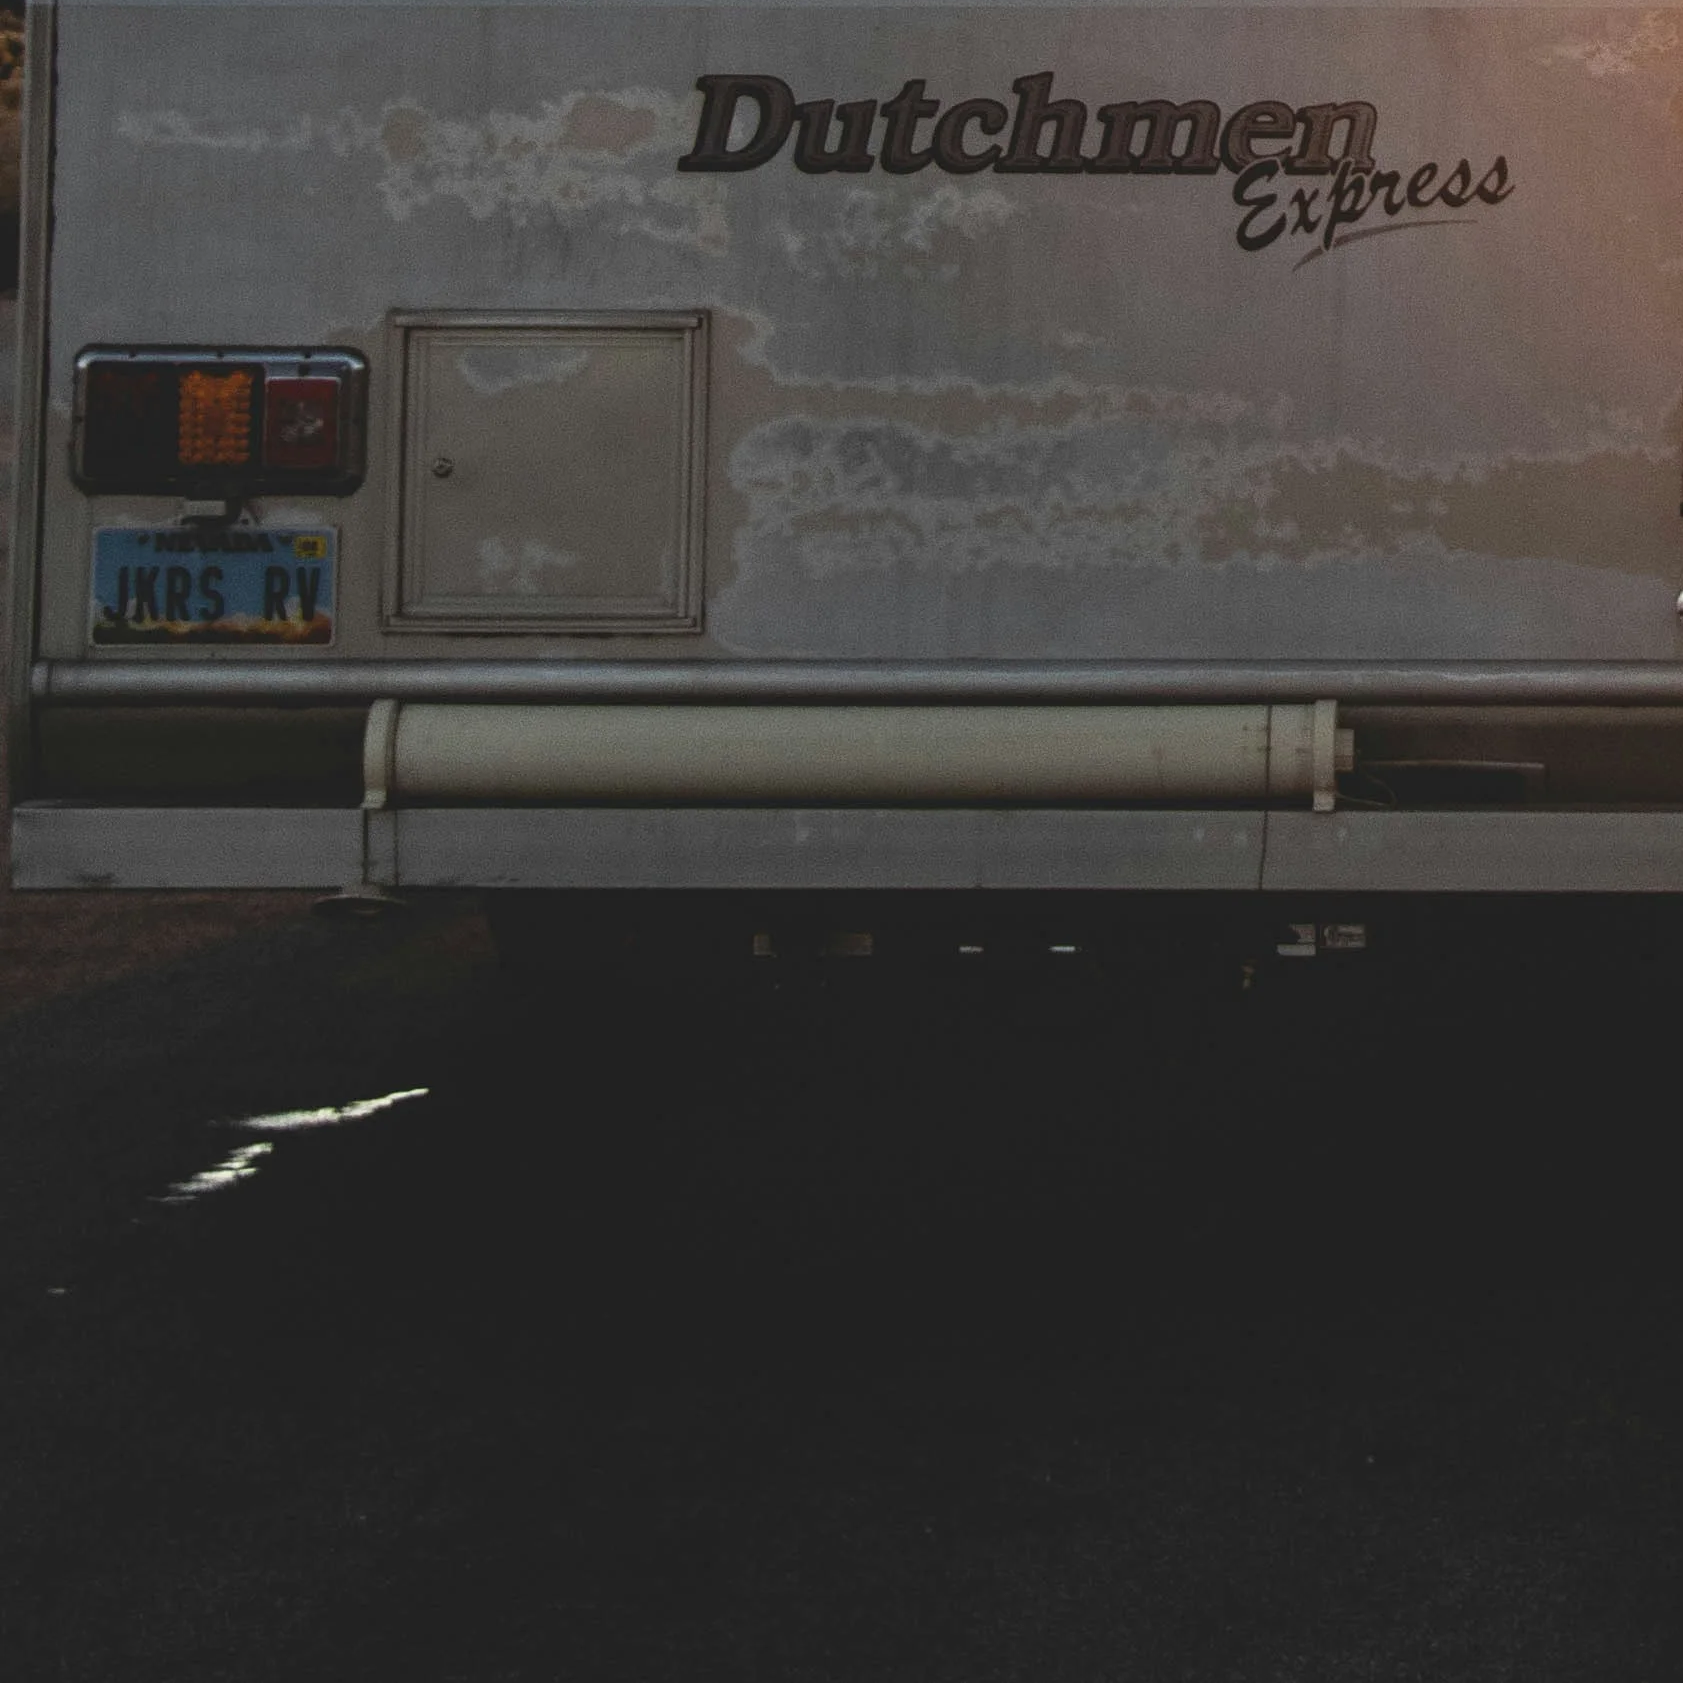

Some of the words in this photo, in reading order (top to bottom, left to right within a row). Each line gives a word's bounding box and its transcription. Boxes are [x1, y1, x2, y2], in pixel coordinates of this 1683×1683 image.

[676, 69, 1381, 175] Dutchmen
[1227, 154, 1517, 252] Express
[103, 565, 226, 623] JKRS
[264, 565, 322, 623] RV
